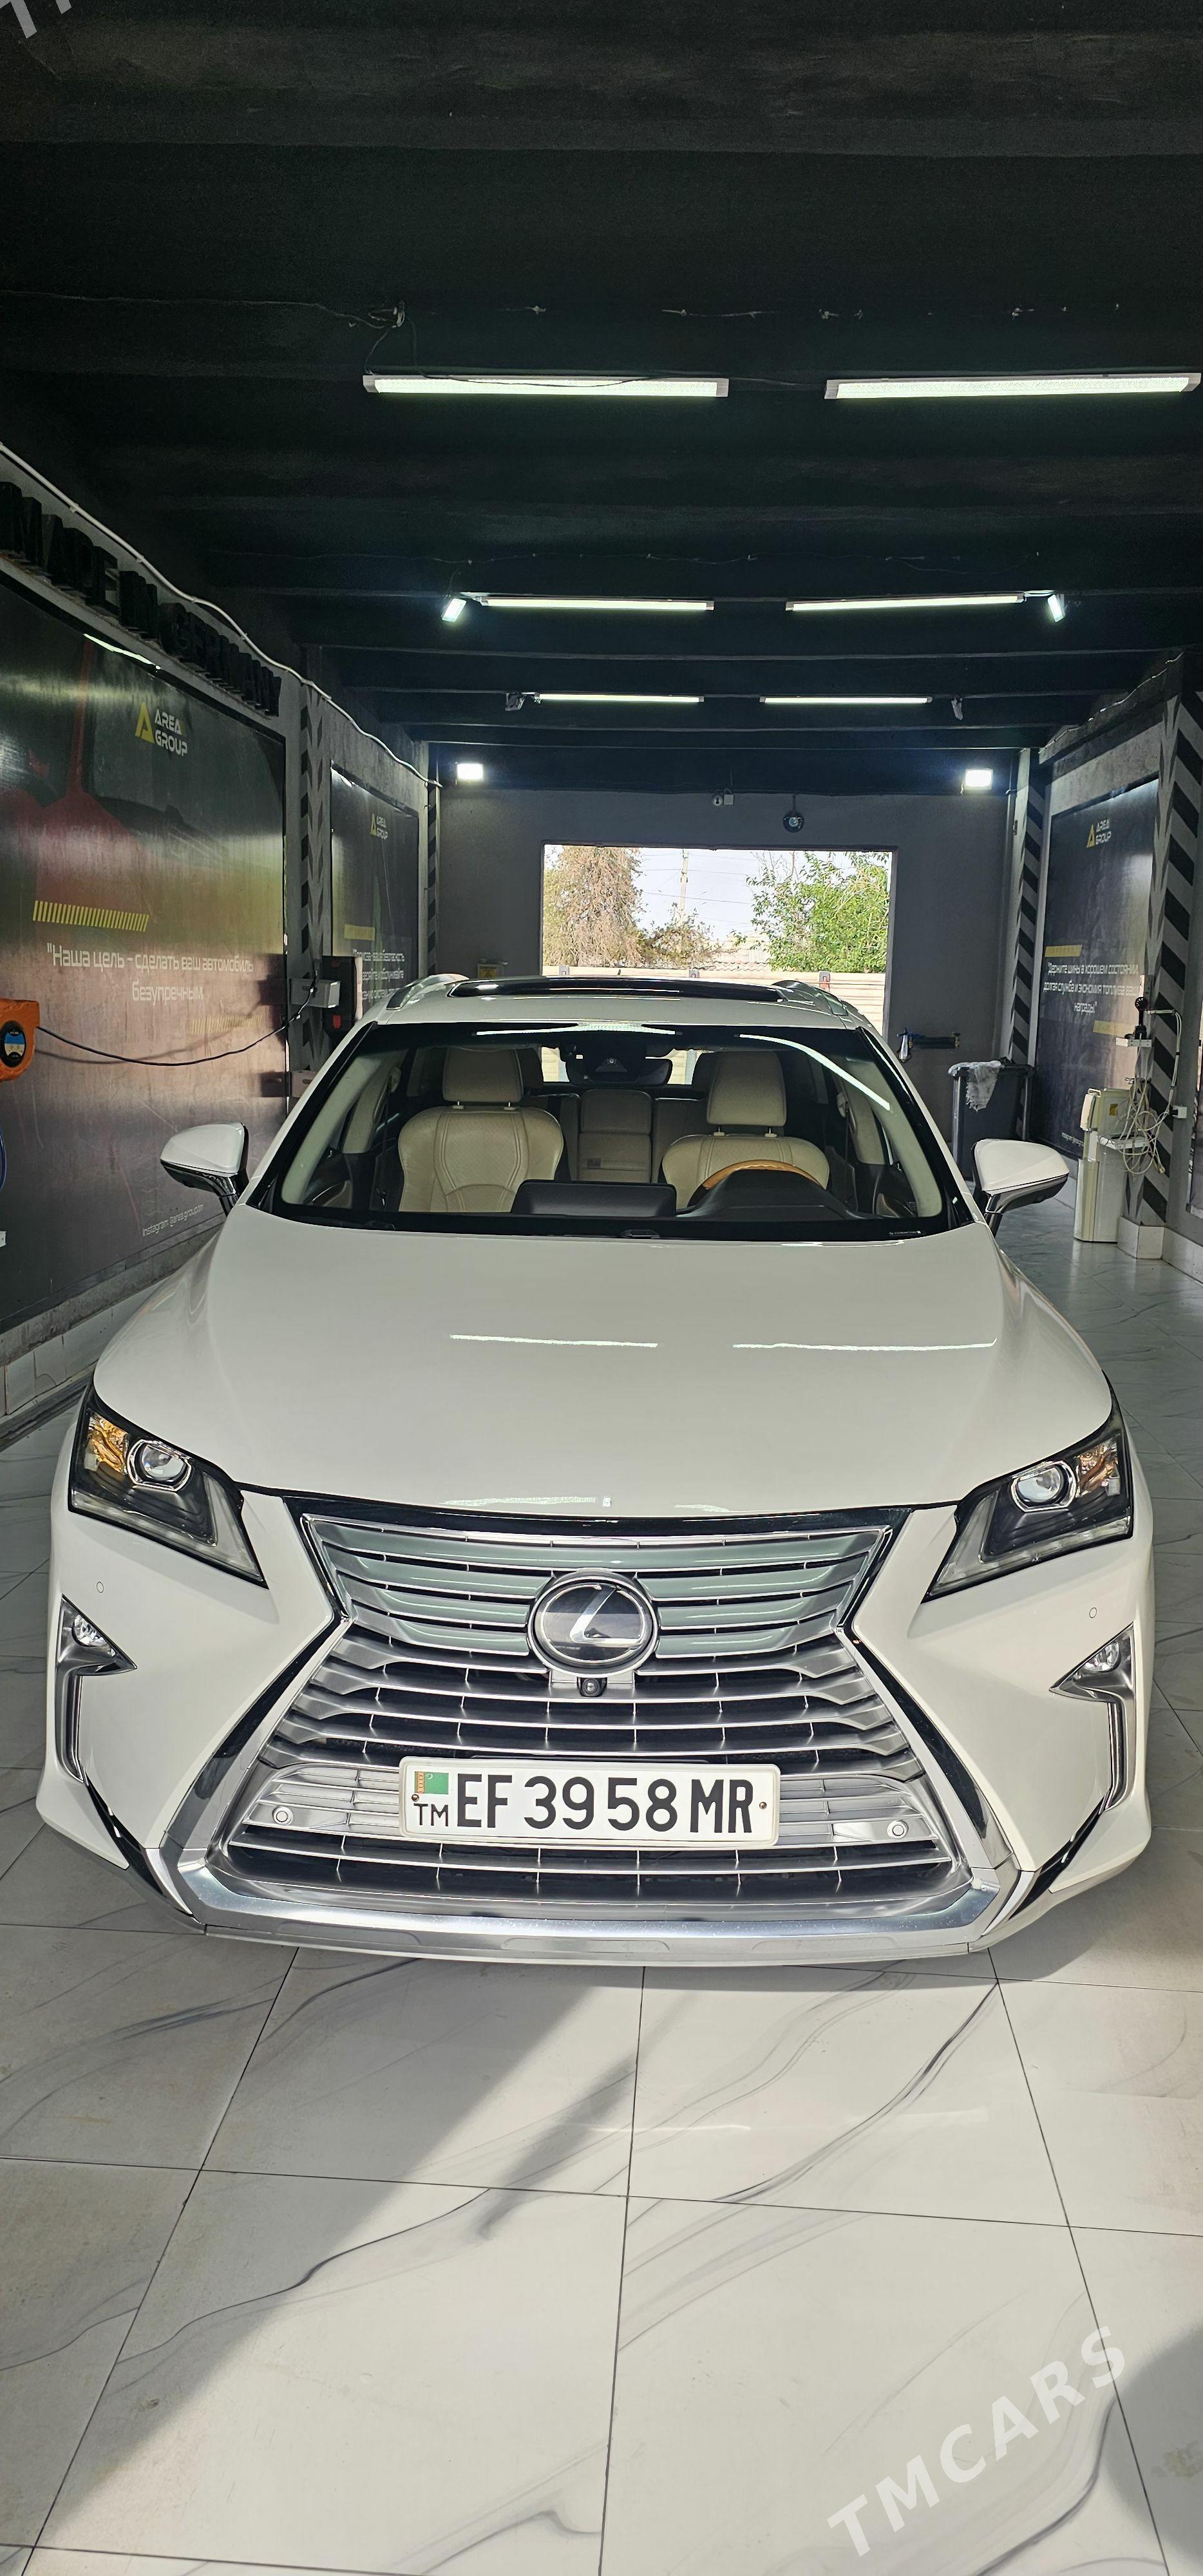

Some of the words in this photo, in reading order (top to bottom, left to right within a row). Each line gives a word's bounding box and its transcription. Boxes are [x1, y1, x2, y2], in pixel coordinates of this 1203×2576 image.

[155, 709, 182, 735] AREA
[155, 730, 187, 756] GROUP
[47, 943, 90, 967] "Наша
[93, 951, 124, 972] цель
[135, 954, 179, 974] сделать
[182, 956, 201, 971] ваш
[202, 953, 254, 972] автомобиль
[132, 979, 204, 1006] безупречным
[413, 1803, 449, 1827] TM
